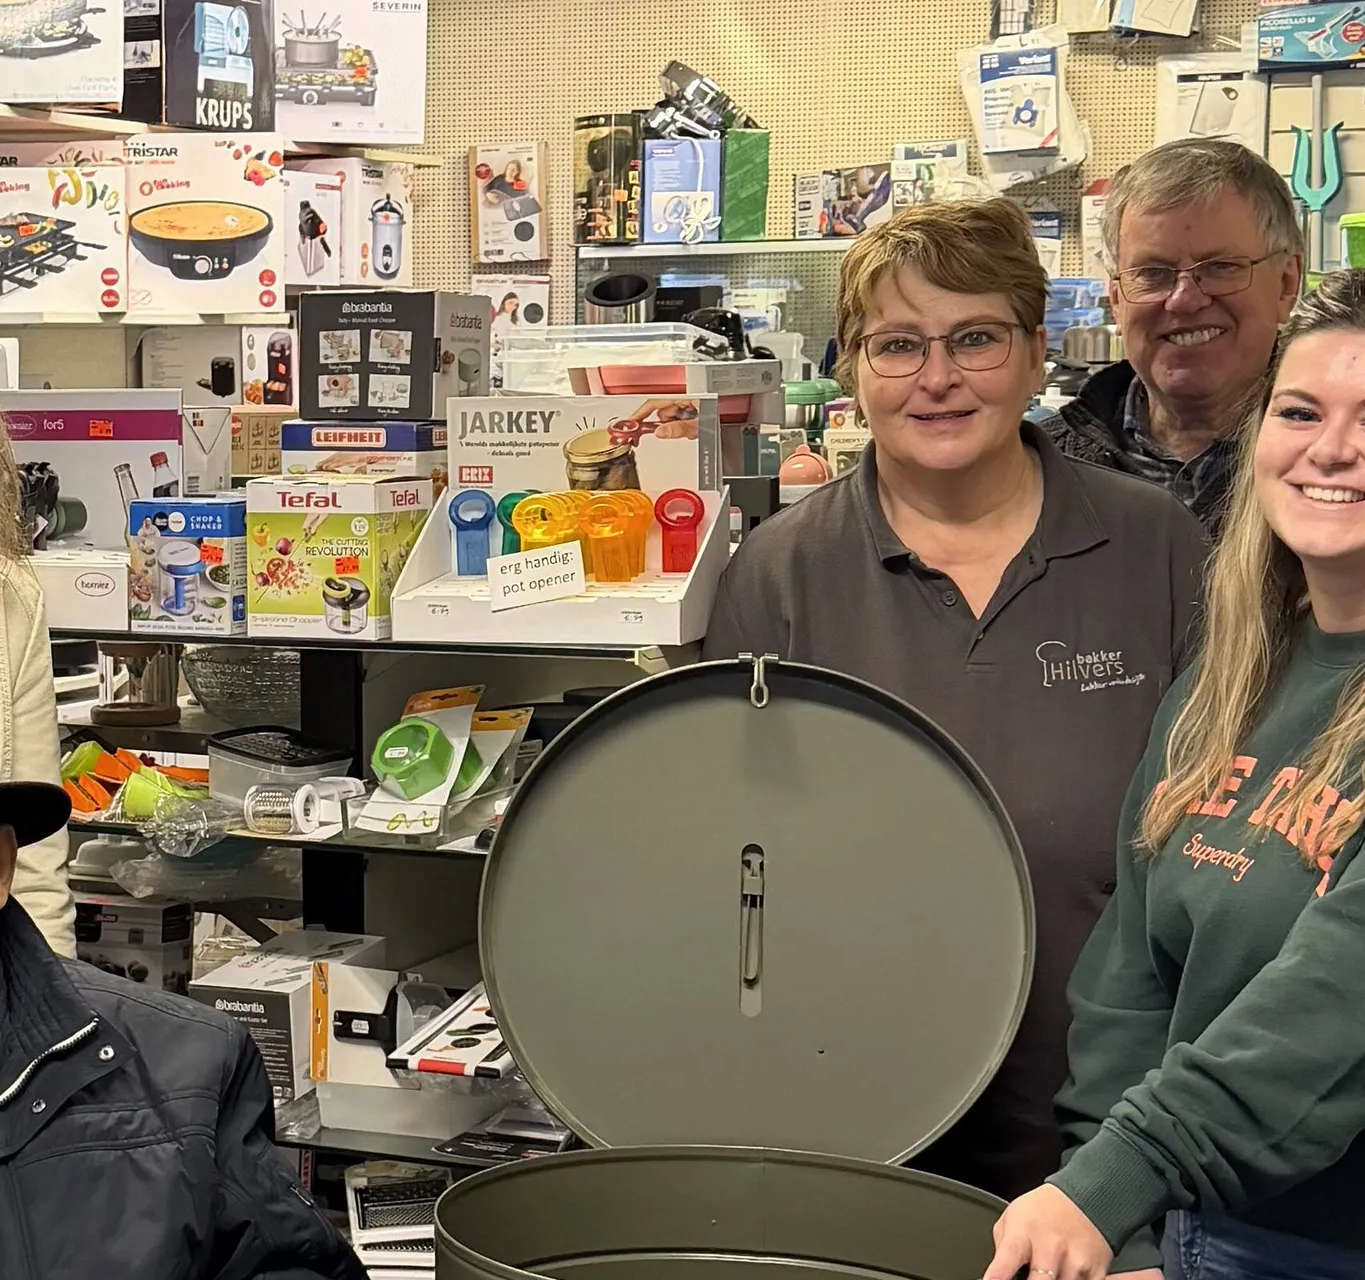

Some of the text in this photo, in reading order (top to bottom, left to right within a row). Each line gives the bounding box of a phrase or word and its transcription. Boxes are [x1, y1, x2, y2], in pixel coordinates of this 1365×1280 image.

[372, 1, 421, 11] SEVERIN
[195, 97, 253, 130] KRUPS
[351, 302, 393, 313] brabantia
[458, 411, 556, 440] JARKEY
[315, 431, 383, 444] LEIFHEIT
[462, 467, 490, 482] BRIX
[277, 491, 342, 508] Tefal
[390, 489, 420, 507] Tefal
[322, 538, 368, 546] THE CUTTING
[305, 546, 369, 557] REVOLUTION
[500, 551, 574, 575] erg handig:
[503, 572, 576, 597] pot opener
[1076, 650, 1122, 665] bakker
[1051, 660, 1124, 681] Hilvers
[1182, 833, 1255, 882] Superdry
[224, 1000, 265, 1014] brabantia
